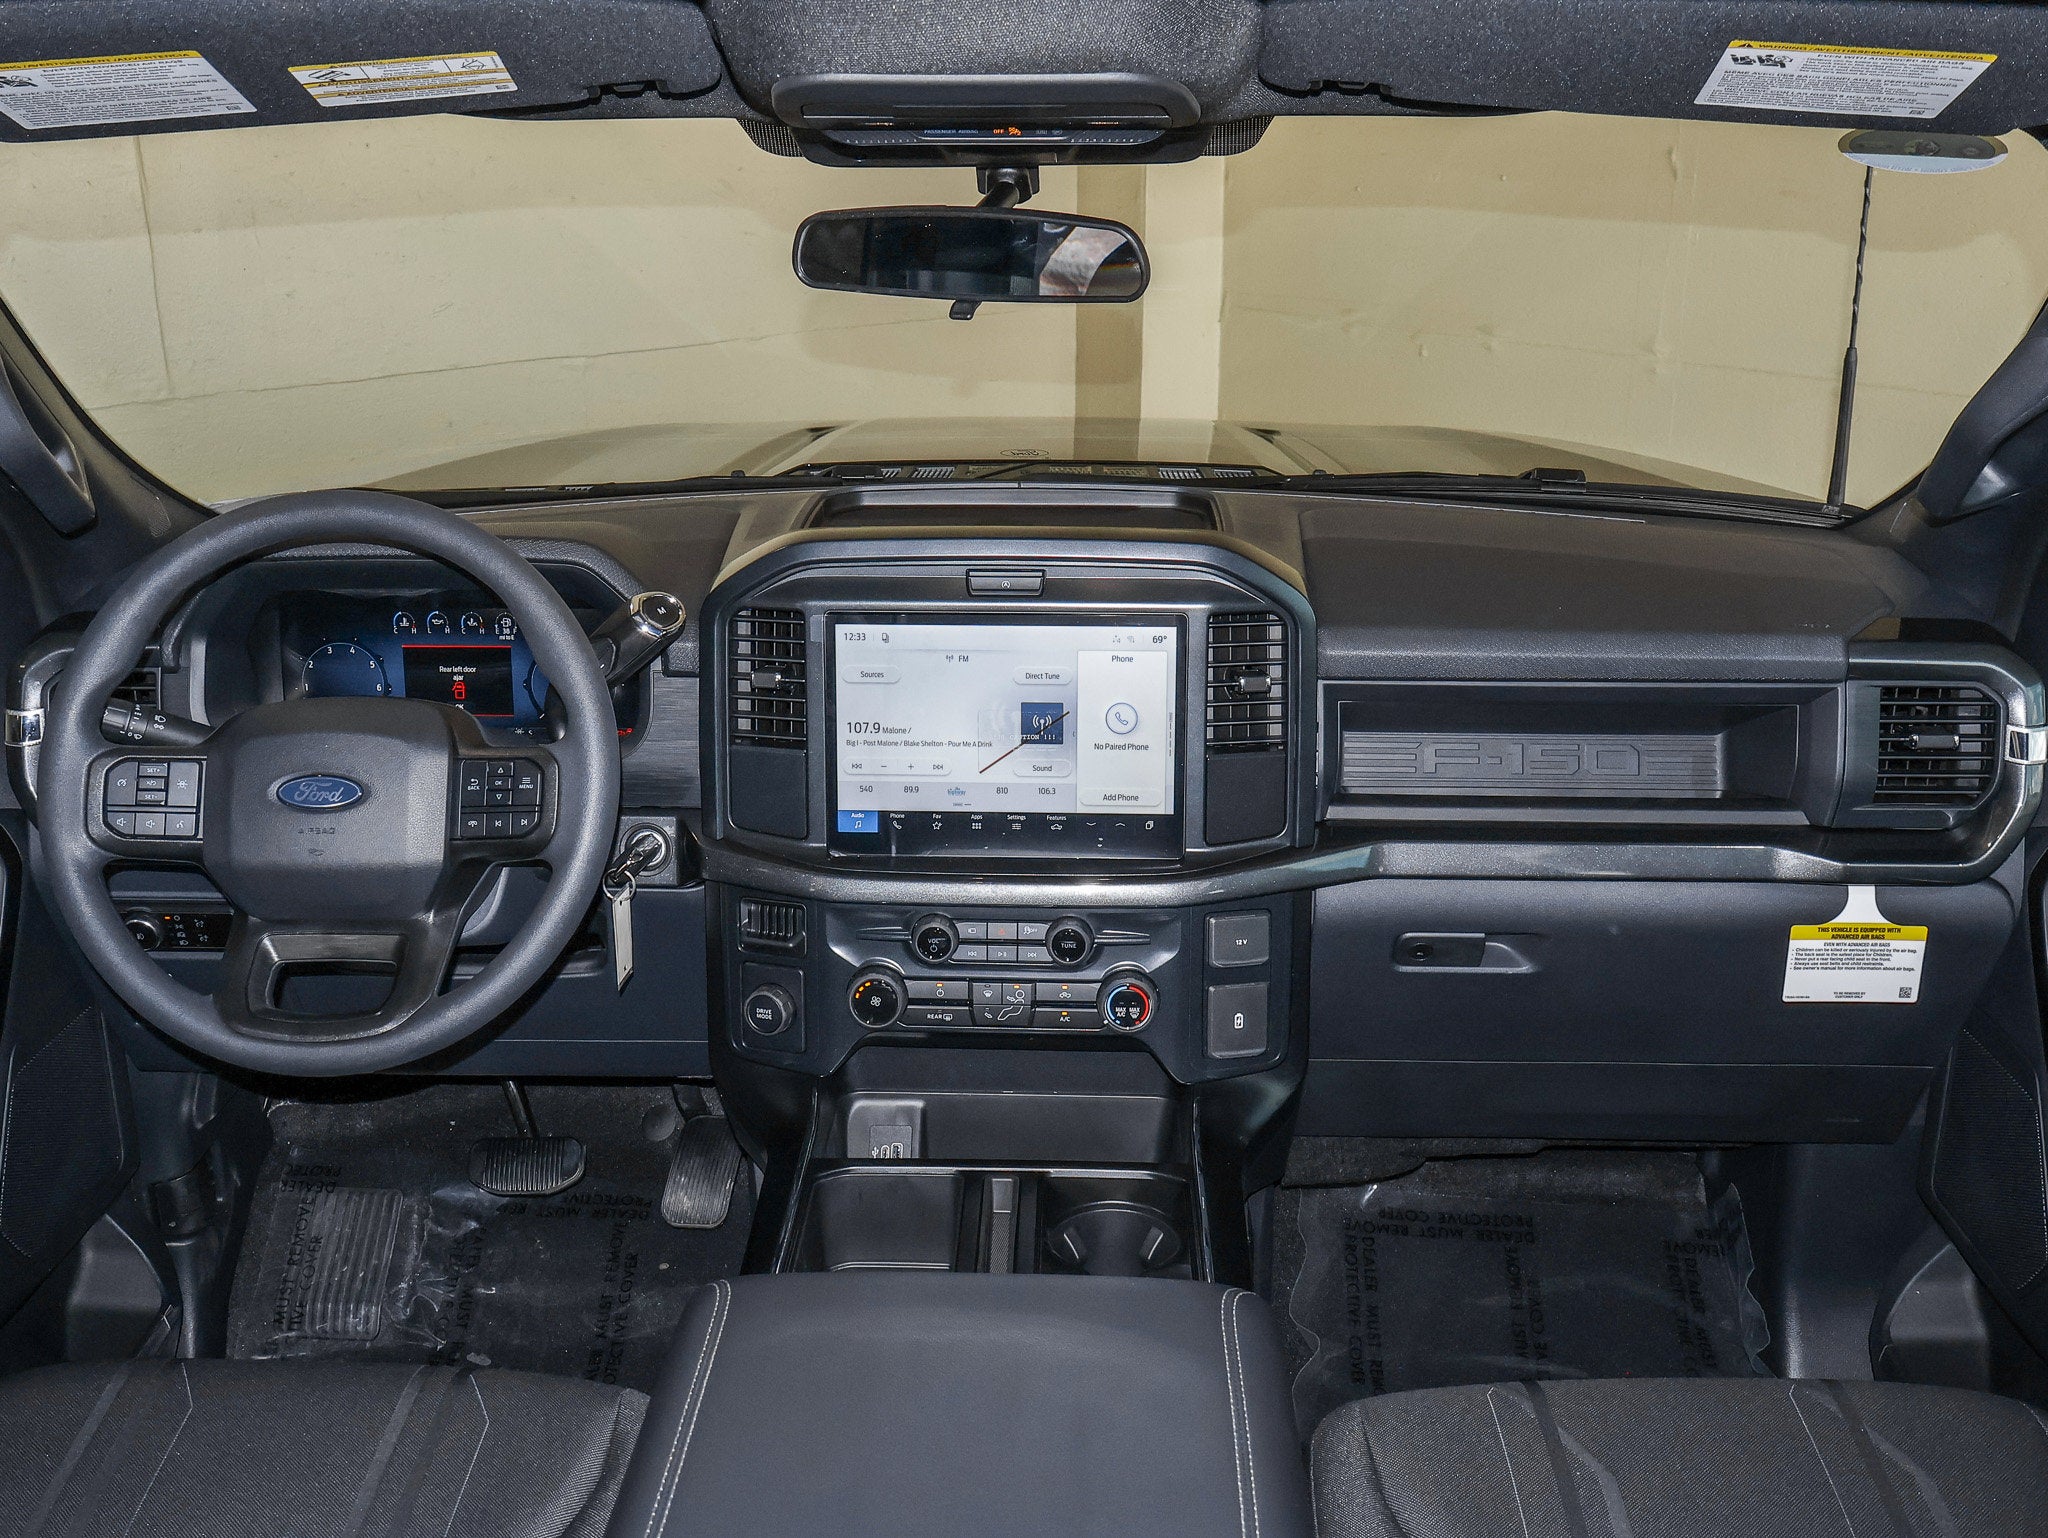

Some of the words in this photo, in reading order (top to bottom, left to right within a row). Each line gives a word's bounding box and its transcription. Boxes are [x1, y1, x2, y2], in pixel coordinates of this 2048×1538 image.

[844, 632, 867, 641] 12:33
[1152, 635, 1168, 644] 69°
[847, 722, 881, 734] 107.9
[1422, 742, 1640, 776] F-150
[294, 781, 344, 802] Ford
[1420, 1226, 1464, 1240] MUST
[299, 1236, 325, 1291] COVER
[618, 1252, 639, 1304] COVER
[1361, 1236, 1379, 1292] DEALER
[1366, 1304, 1382, 1348] MUST
[1348, 1336, 1366, 1386] COVER
